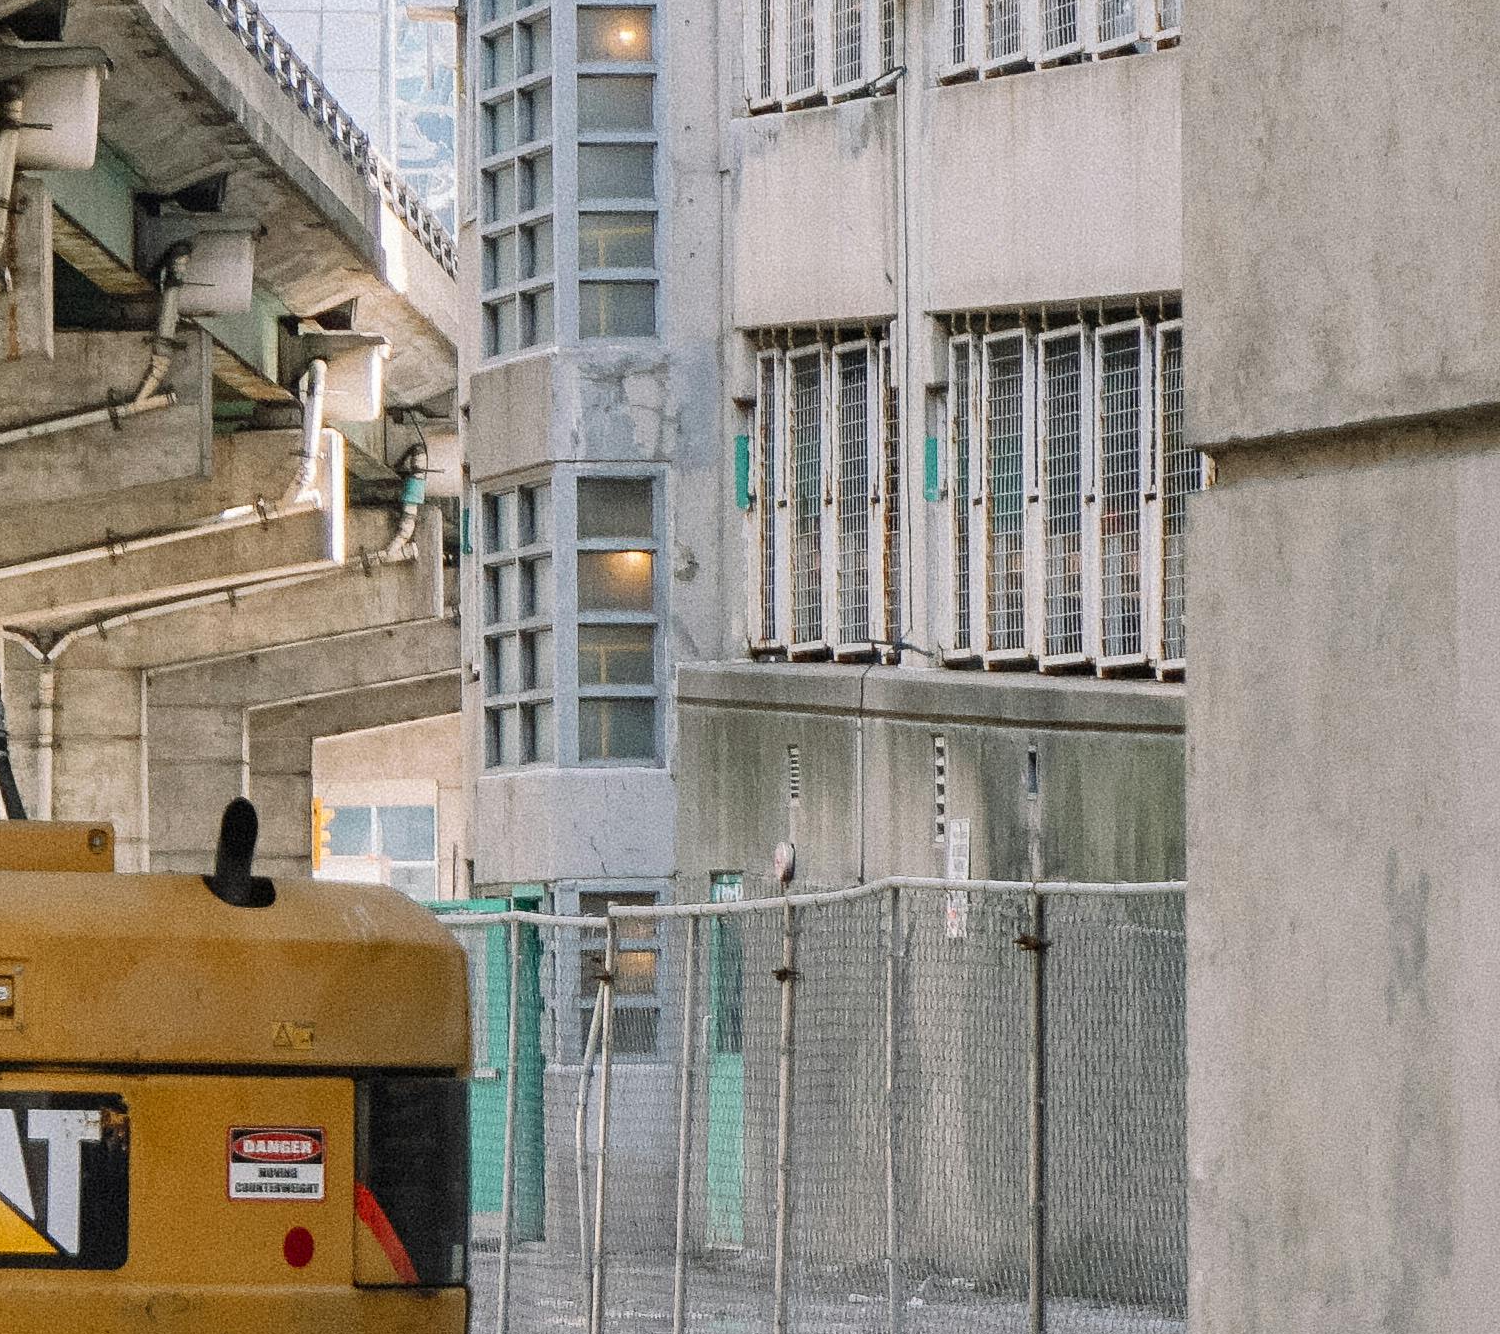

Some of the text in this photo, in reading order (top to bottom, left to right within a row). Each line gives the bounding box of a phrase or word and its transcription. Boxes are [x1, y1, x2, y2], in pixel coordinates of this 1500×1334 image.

[242, 1139, 312, 1155] DANGER
[257, 1167, 299, 1179] MOVING
[235, 1182, 320, 1194] COUNTERWEIGHT
